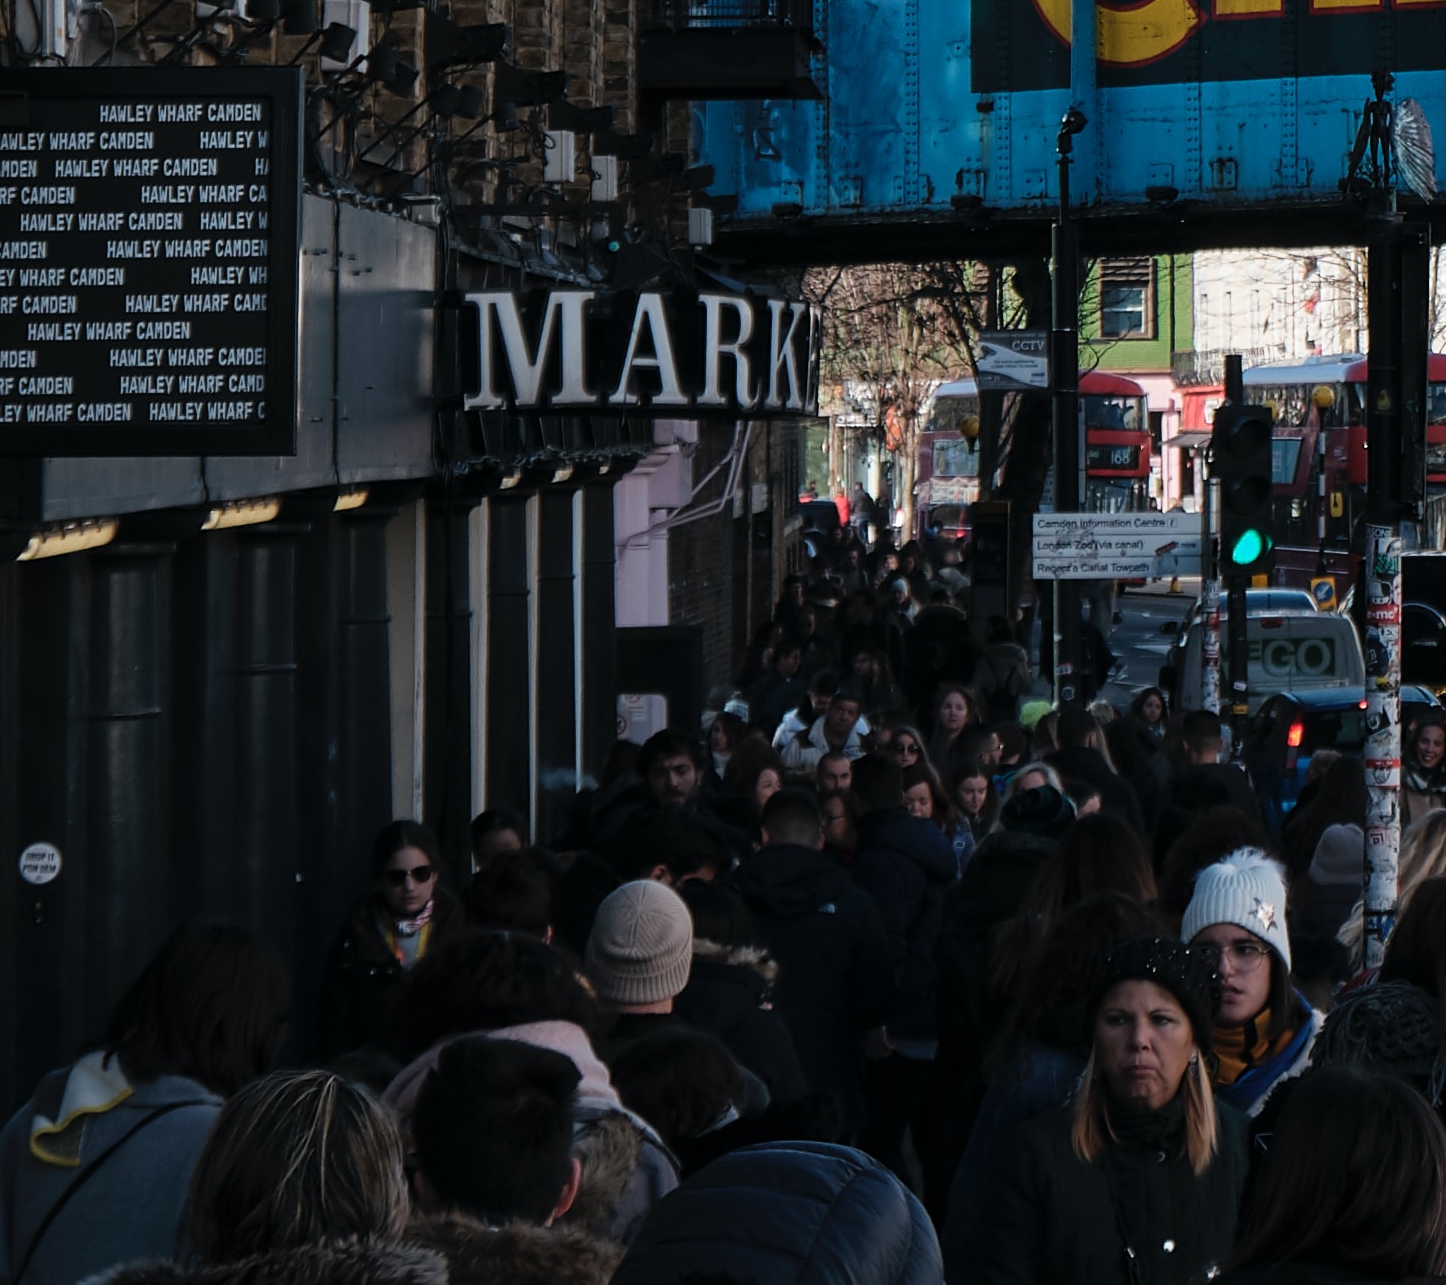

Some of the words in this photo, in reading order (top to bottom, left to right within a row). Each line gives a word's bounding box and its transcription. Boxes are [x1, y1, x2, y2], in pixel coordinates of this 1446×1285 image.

[100, 105, 153, 122] HAWLEY
[158, 105, 202, 121] WHARF
[208, 104, 261, 121] CAMDEN
[50, 133, 95, 149] WHARF
[100, 132, 153, 149] CAMDEN
[200, 131, 253, 148] HAWLEY
[56, 160, 108, 177] HAWLEY
[114, 159, 158, 176] WHARF
[164, 159, 217, 176] CAMDEN
[21, 187, 74, 204] CAMDEN
[142, 186, 194, 203] HAWLEY
[199, 185, 244, 202] WHARF
[21, 214, 73, 231] HAWLEY
[79, 213, 123, 230] WHARF
[129, 213, 182, 230] CAMDEN
[201, 212, 253, 229] HAWLEY
[107, 240, 160, 258] HAWLEY
[165, 240, 210, 257] WHARF
[20, 269, 65, 286] WHARF
[70, 268, 123, 285] CAMDEN
[191, 267, 244, 284] HAWLEY
[23, 296, 76, 313] CAMDEN
[126, 295, 179, 312] HAWLEY
[184, 294, 229, 312] WHARF
[28, 323, 81, 340] HAWLEY
[87, 322, 131, 340] WHARF
[137, 322, 190, 339] CAMDEN
[463, 291, 821, 414] MARK
[1011, 339, 1044, 351] CCTV
[110, 349, 163, 366] HAWLEY
[168, 349, 213, 366] WHARF
[219, 348, 265, 365] CAMDE
[19, 377, 72, 394] CAMDEN
[121, 376, 174, 394] HAWLEY
[179, 375, 223, 393] WHARF
[27, 404, 72, 421] WHARF
[78, 404, 131, 421] CAMDEN
[150, 403, 203, 420] HAWLEY
[208, 402, 252, 419] WHARF
[1080, 518, 1132, 529] Information
